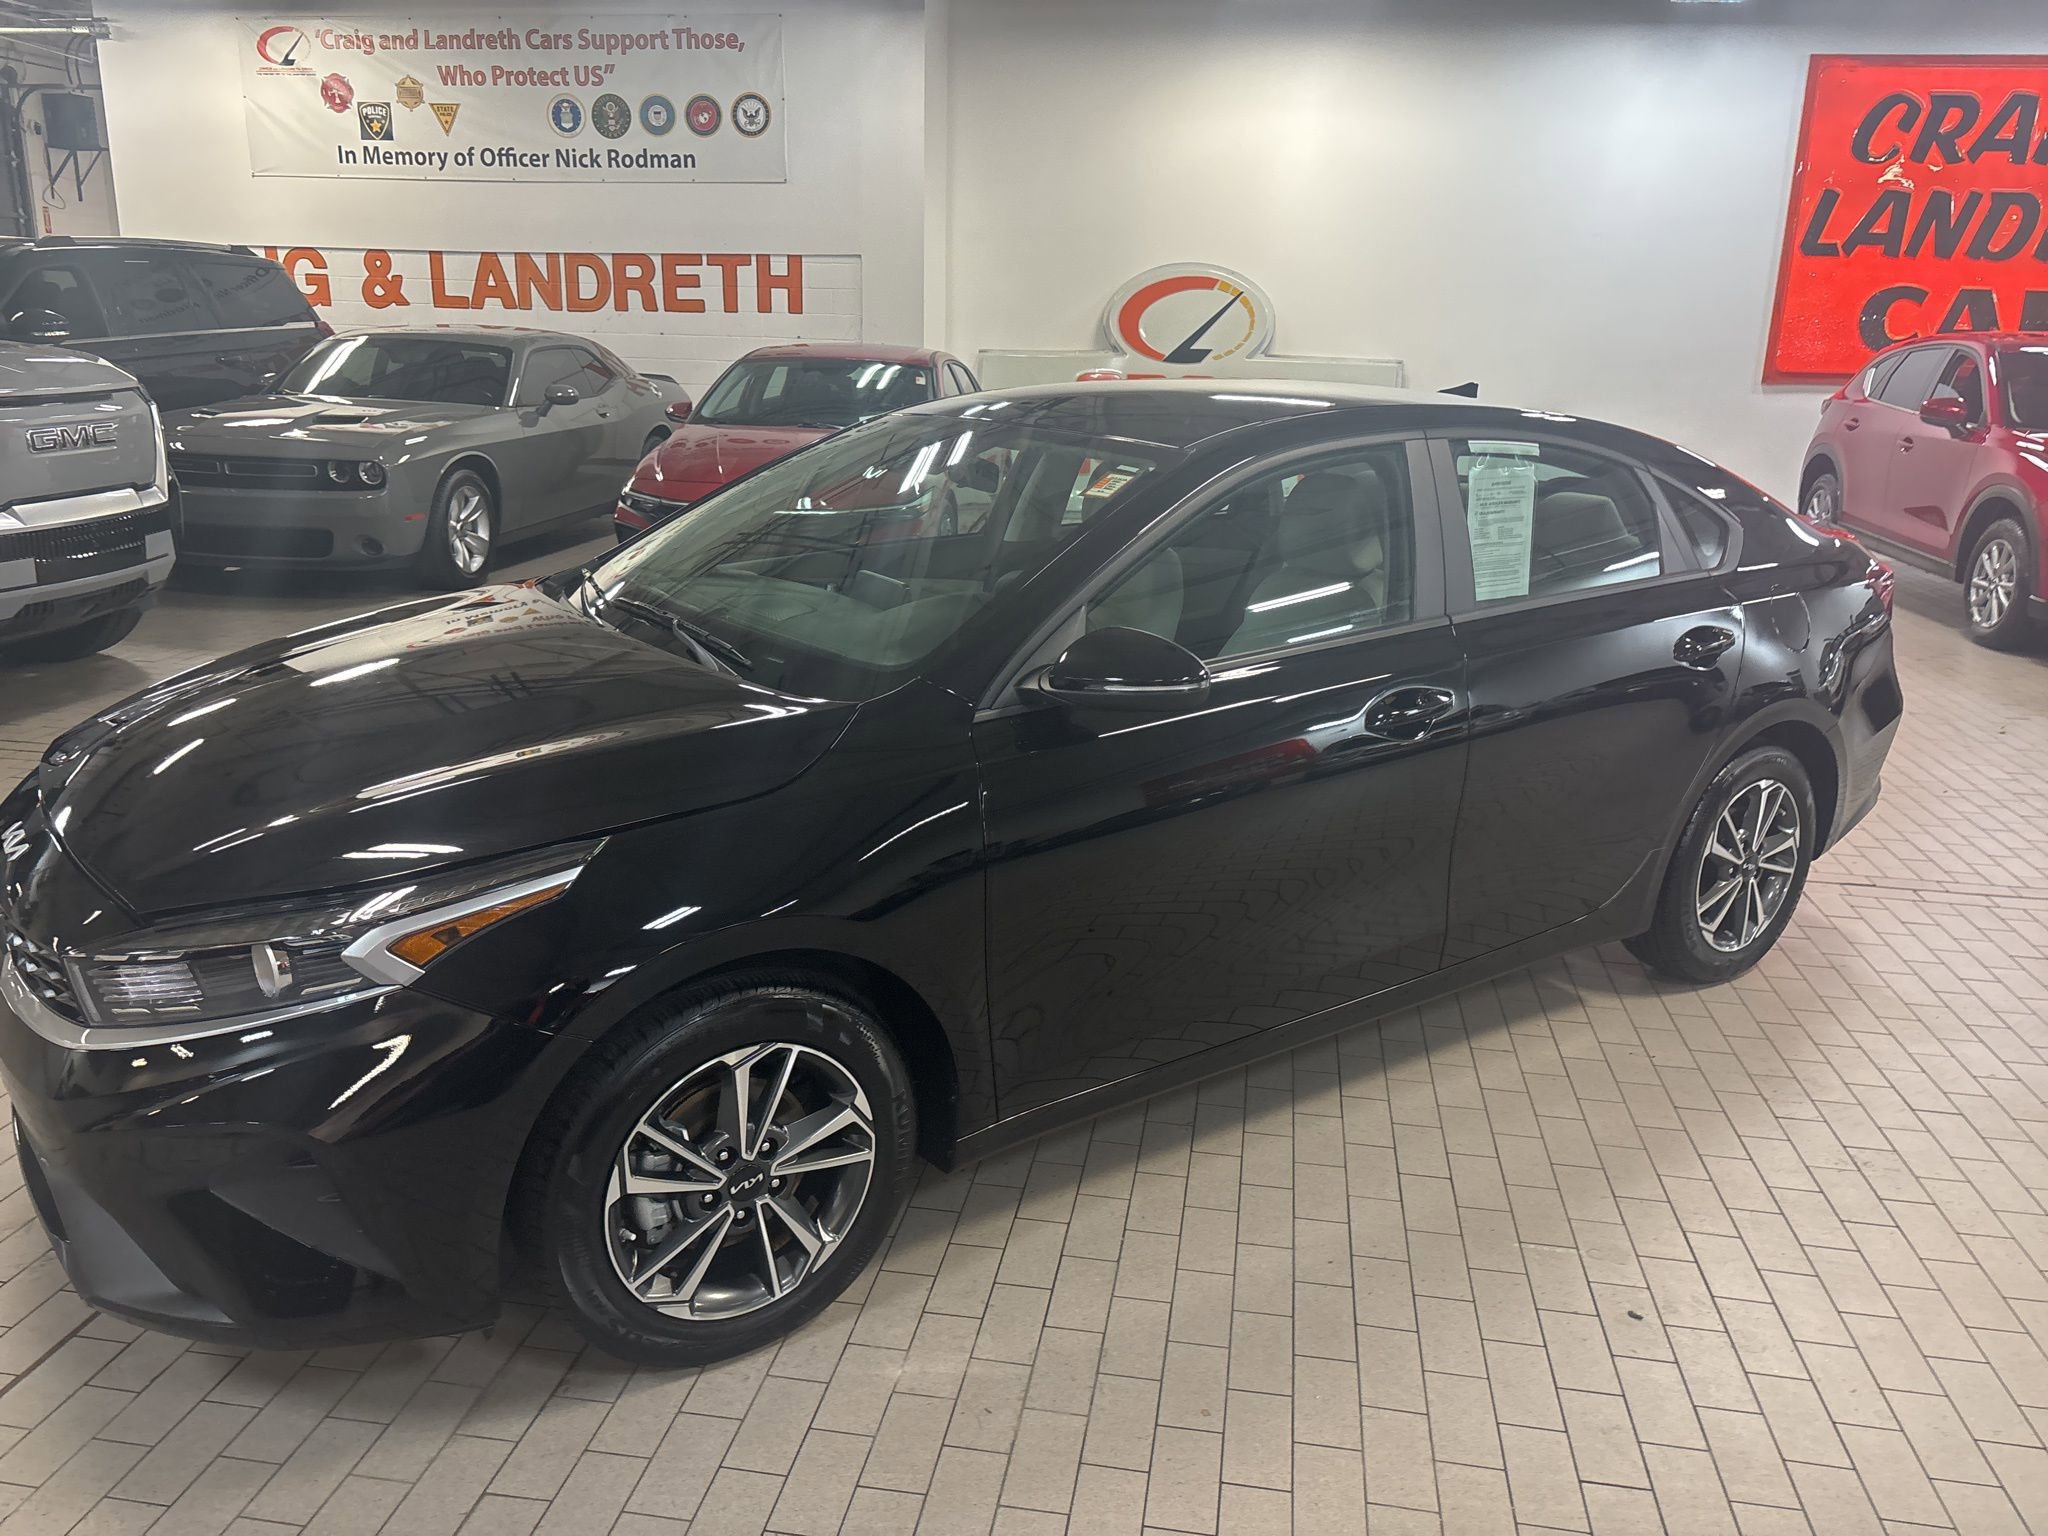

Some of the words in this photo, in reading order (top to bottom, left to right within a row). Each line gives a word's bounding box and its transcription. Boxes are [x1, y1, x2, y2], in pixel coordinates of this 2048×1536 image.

[379, 28, 418, 50] and
[423, 27, 521, 50] Landreth
[525, 28, 572, 50] Cars
[577, 28, 669, 56] Support
[671, 27, 745, 52] Those,
[437, 64, 486, 87] Who
[491, 65, 569, 87] Protect
[362, 106, 388, 117] POLICE
[1851, 90, 2048, 164] CRA
[337, 145, 357, 164] In
[362, 146, 448, 171] Memory
[454, 146, 475, 166] of
[480, 147, 549, 168] Officer
[555, 148, 602, 168] Nick
[607, 148, 696, 169] Rodman
[1799, 188, 2048, 263] LAND
[361, 248, 410, 307] &
[427, 250, 804, 315] LANDRETH
[27, 422, 118, 453] GMC
